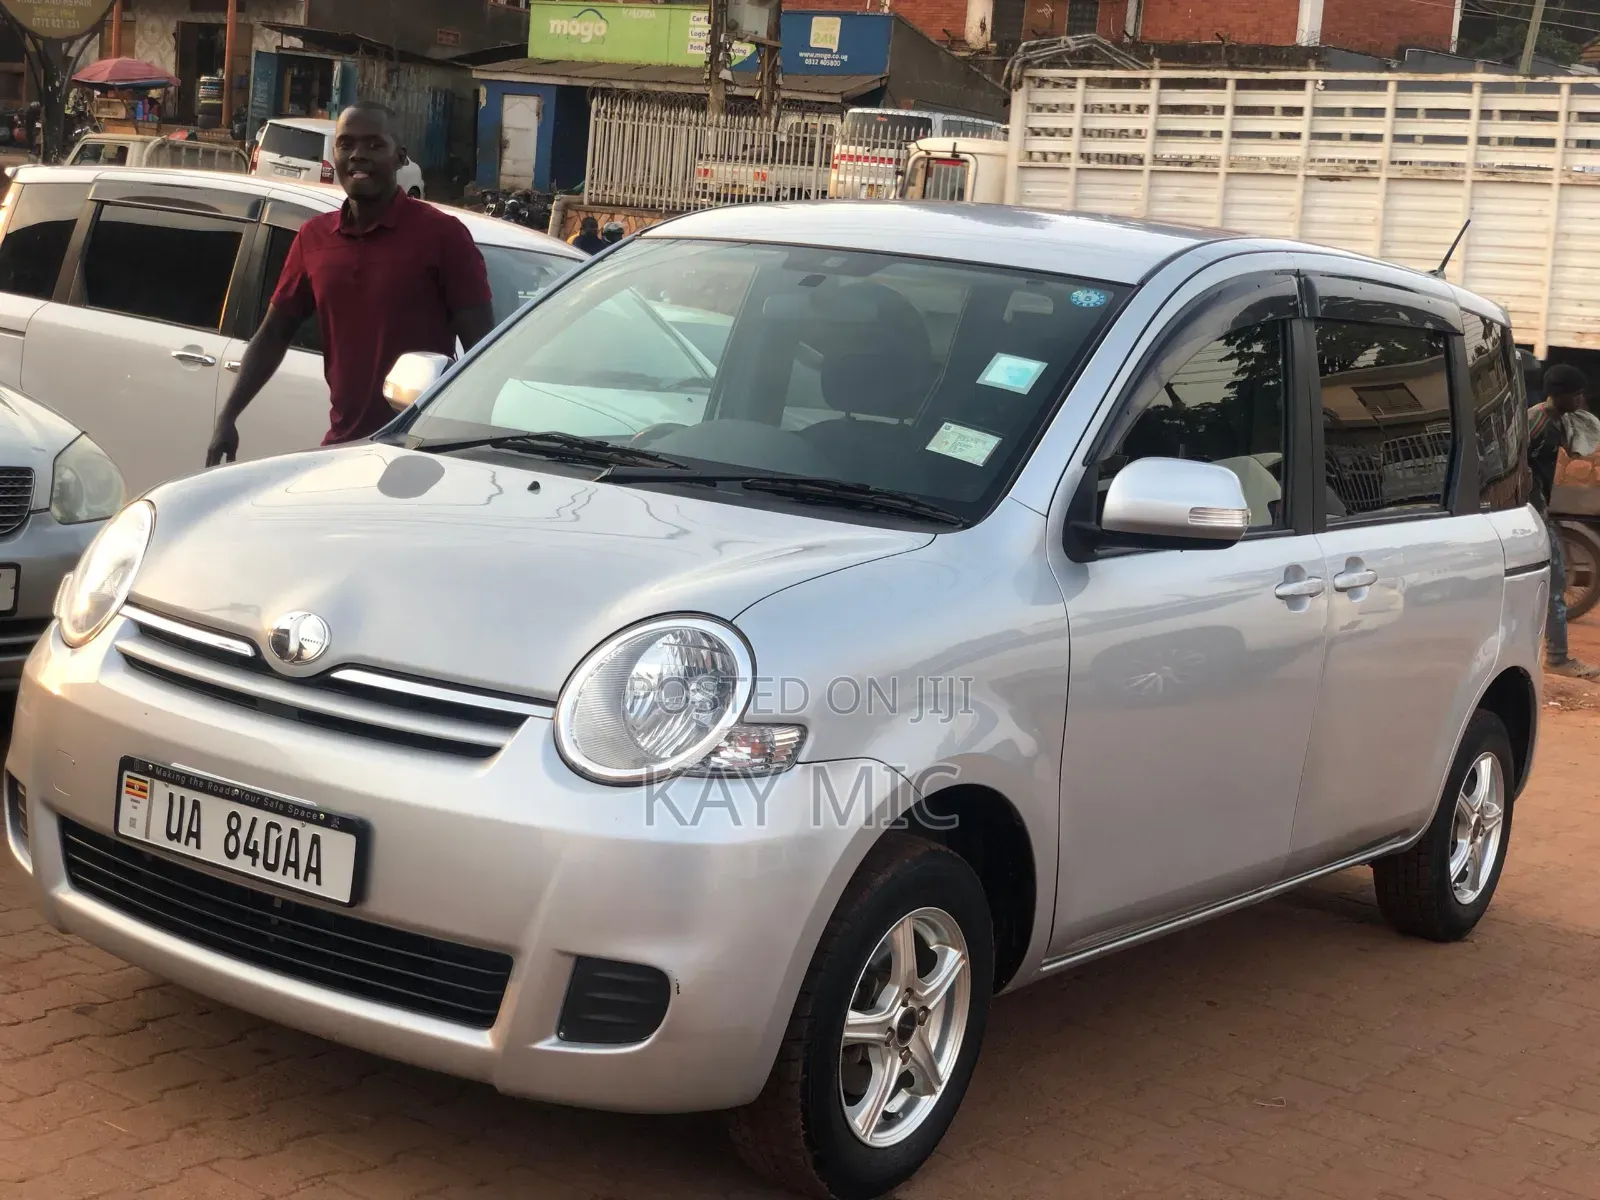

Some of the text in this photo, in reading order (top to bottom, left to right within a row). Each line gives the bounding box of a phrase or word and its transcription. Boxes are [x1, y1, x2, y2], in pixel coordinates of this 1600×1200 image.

[549, 19, 607, 44] mogo
[804, 58, 819, 66] 0312
[155, 767, 319, 821] Making the Roads Your Safe Space
[165, 791, 322, 887] UA 840AA
